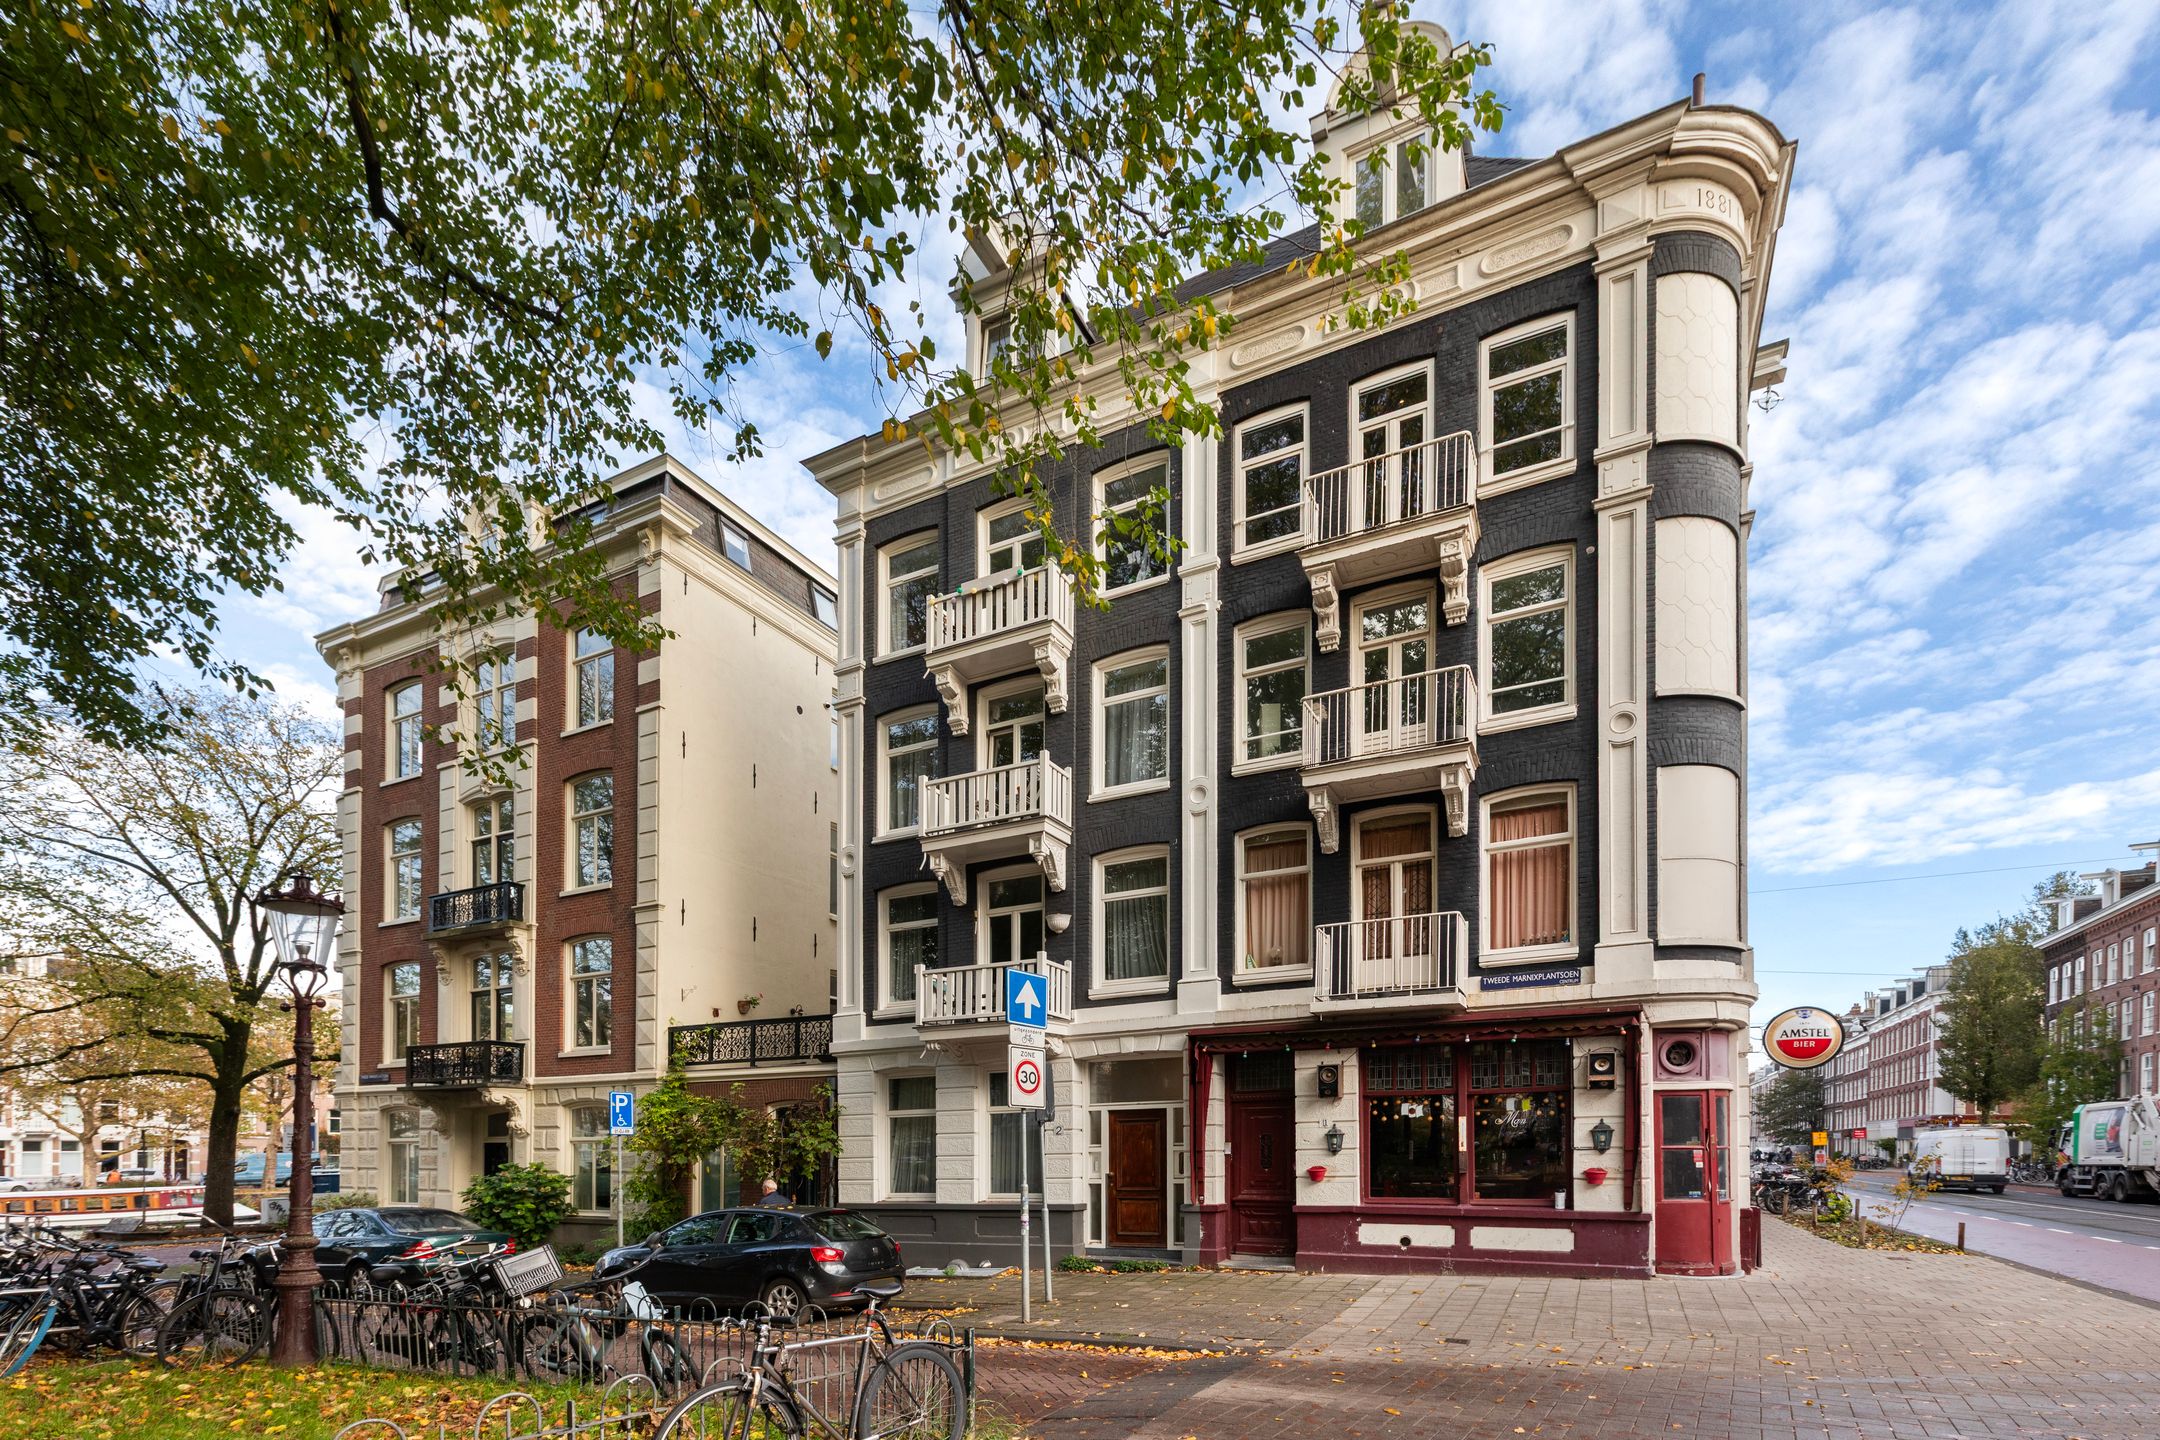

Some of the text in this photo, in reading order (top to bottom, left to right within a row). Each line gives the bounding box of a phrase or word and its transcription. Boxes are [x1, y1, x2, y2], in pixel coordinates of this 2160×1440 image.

[1697, 188, 1731, 218] 1881
[1483, 970, 1580, 985] TWEEDE MARNIXPLANTSOEN
[1780, 1028, 1829, 1038] AMSTEL
[1793, 1040, 1816, 1048] BIER
[1020, 1050, 1036, 1058] ZONE
[1020, 1070, 1037, 1084] 30
[616, 1095, 628, 1113] P
[1055, 1126, 1062, 1135] 2
